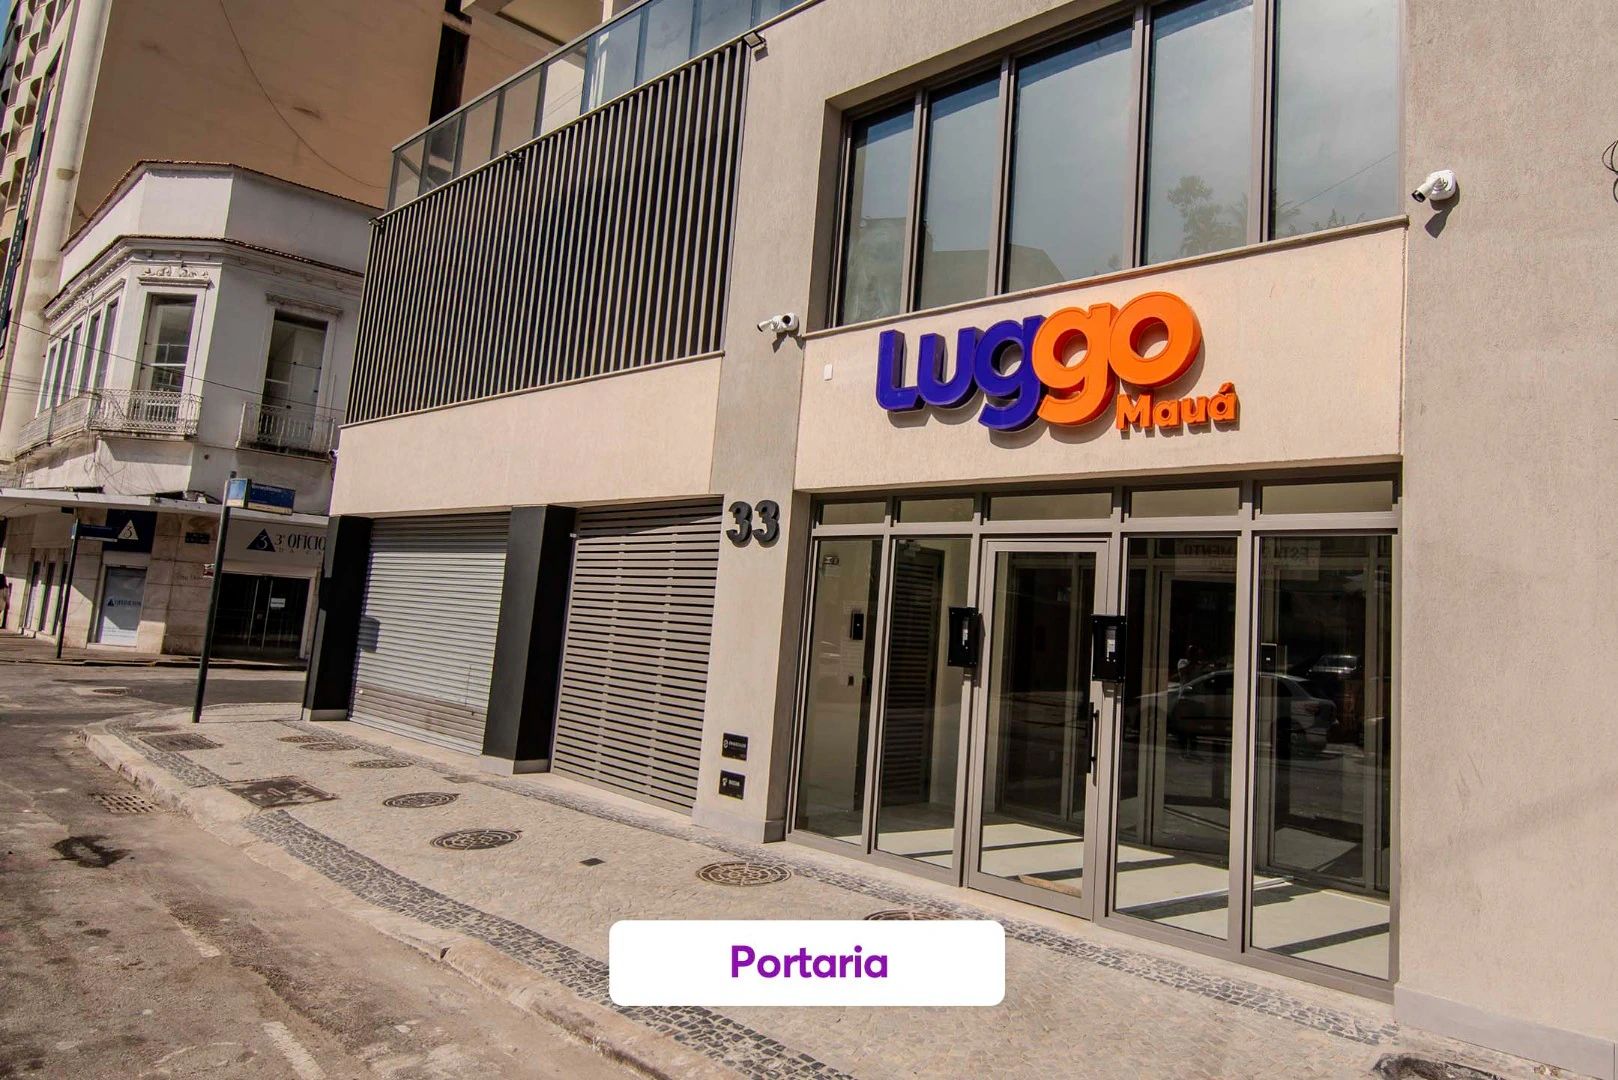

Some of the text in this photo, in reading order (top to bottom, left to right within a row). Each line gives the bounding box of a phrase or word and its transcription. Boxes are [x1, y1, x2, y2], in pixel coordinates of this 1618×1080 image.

[1116, 381, 1238, 432] Mauá
[123, 525, 134, 539] 3
[727, 499, 779, 547] 33
[256, 534, 268, 549] 3
